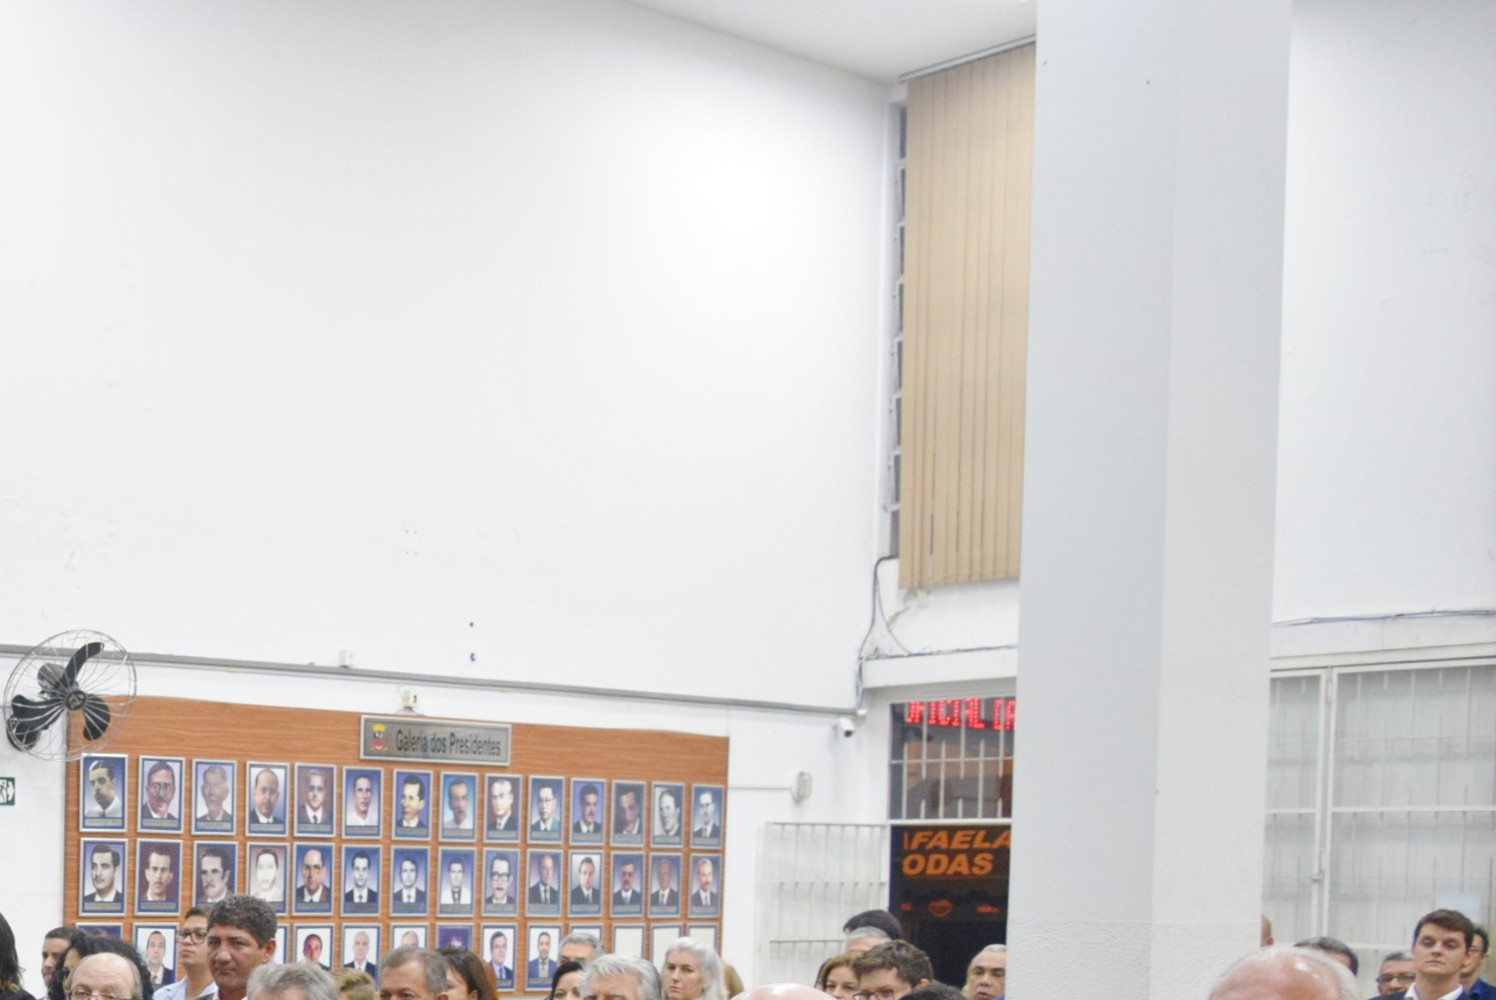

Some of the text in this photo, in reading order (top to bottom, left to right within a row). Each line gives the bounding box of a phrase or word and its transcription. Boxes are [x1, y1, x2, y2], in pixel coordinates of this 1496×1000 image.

[396, 729, 501, 757] Galeria dos Presidentes
[904, 830, 1011, 850] FAELA
